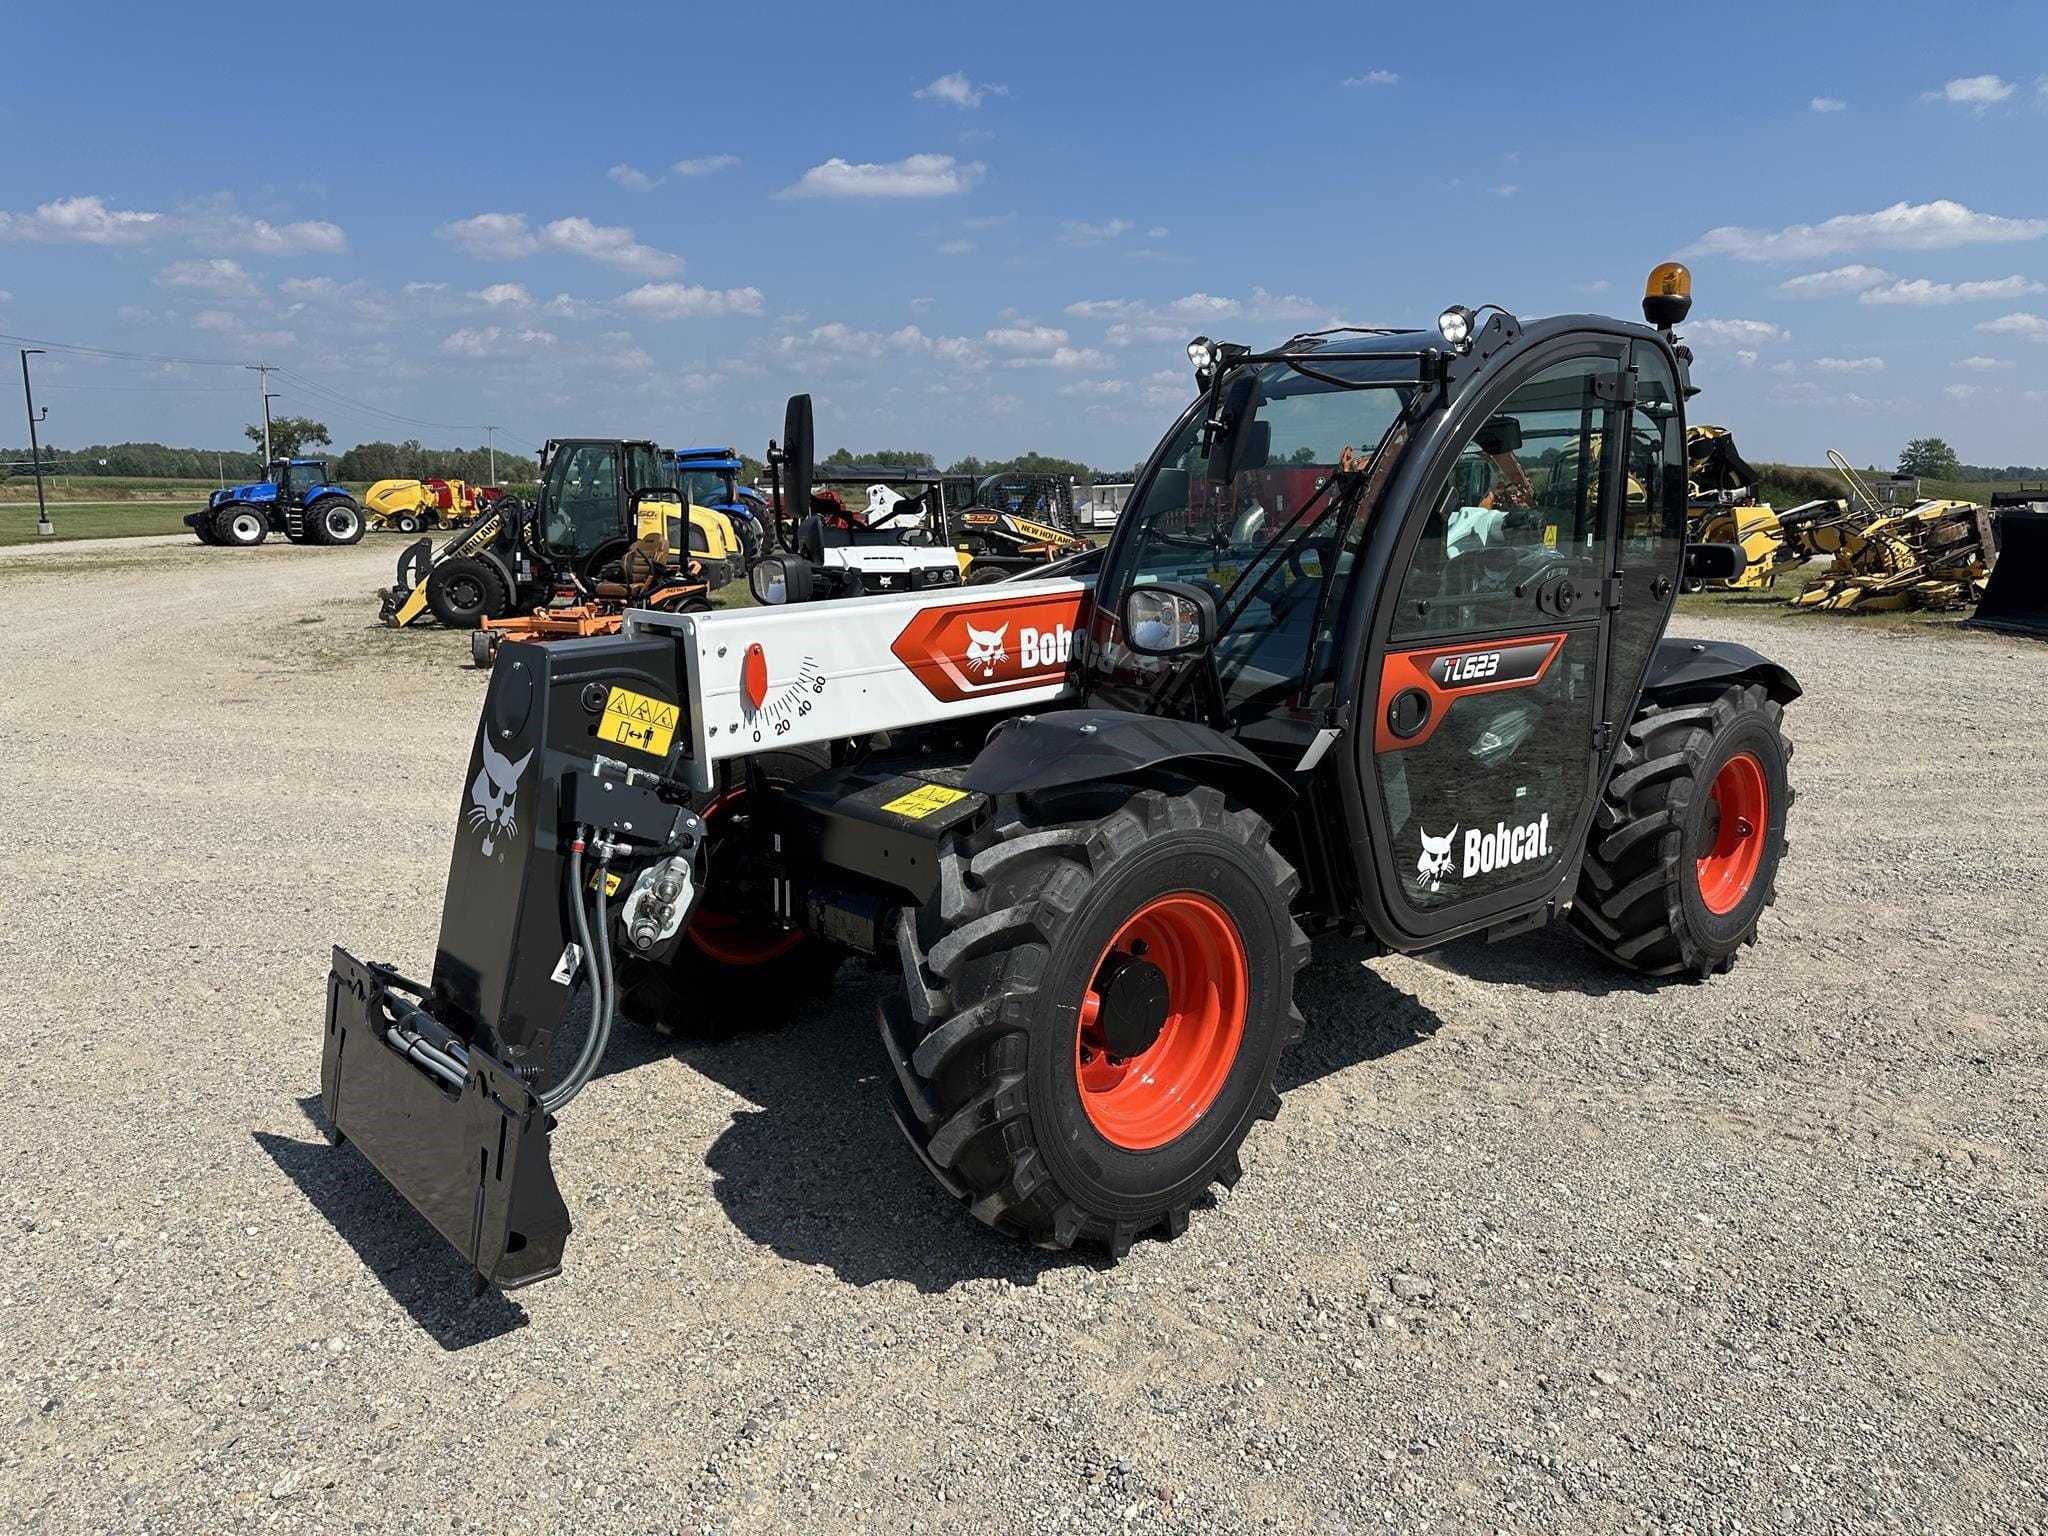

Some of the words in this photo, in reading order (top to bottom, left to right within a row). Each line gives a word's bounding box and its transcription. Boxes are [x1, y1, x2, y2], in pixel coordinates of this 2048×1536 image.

[1021, 524, 1040, 536] NEW
[1040, 530, 1073, 544] HOLLAND
[1444, 653, 1500, 682] TL623
[812, 676, 826, 694] 60
[798, 700, 812, 717] 40
[753, 730, 761, 743] 0
[775, 719, 791, 736] 20
[1463, 812, 1549, 879] Bobcat
